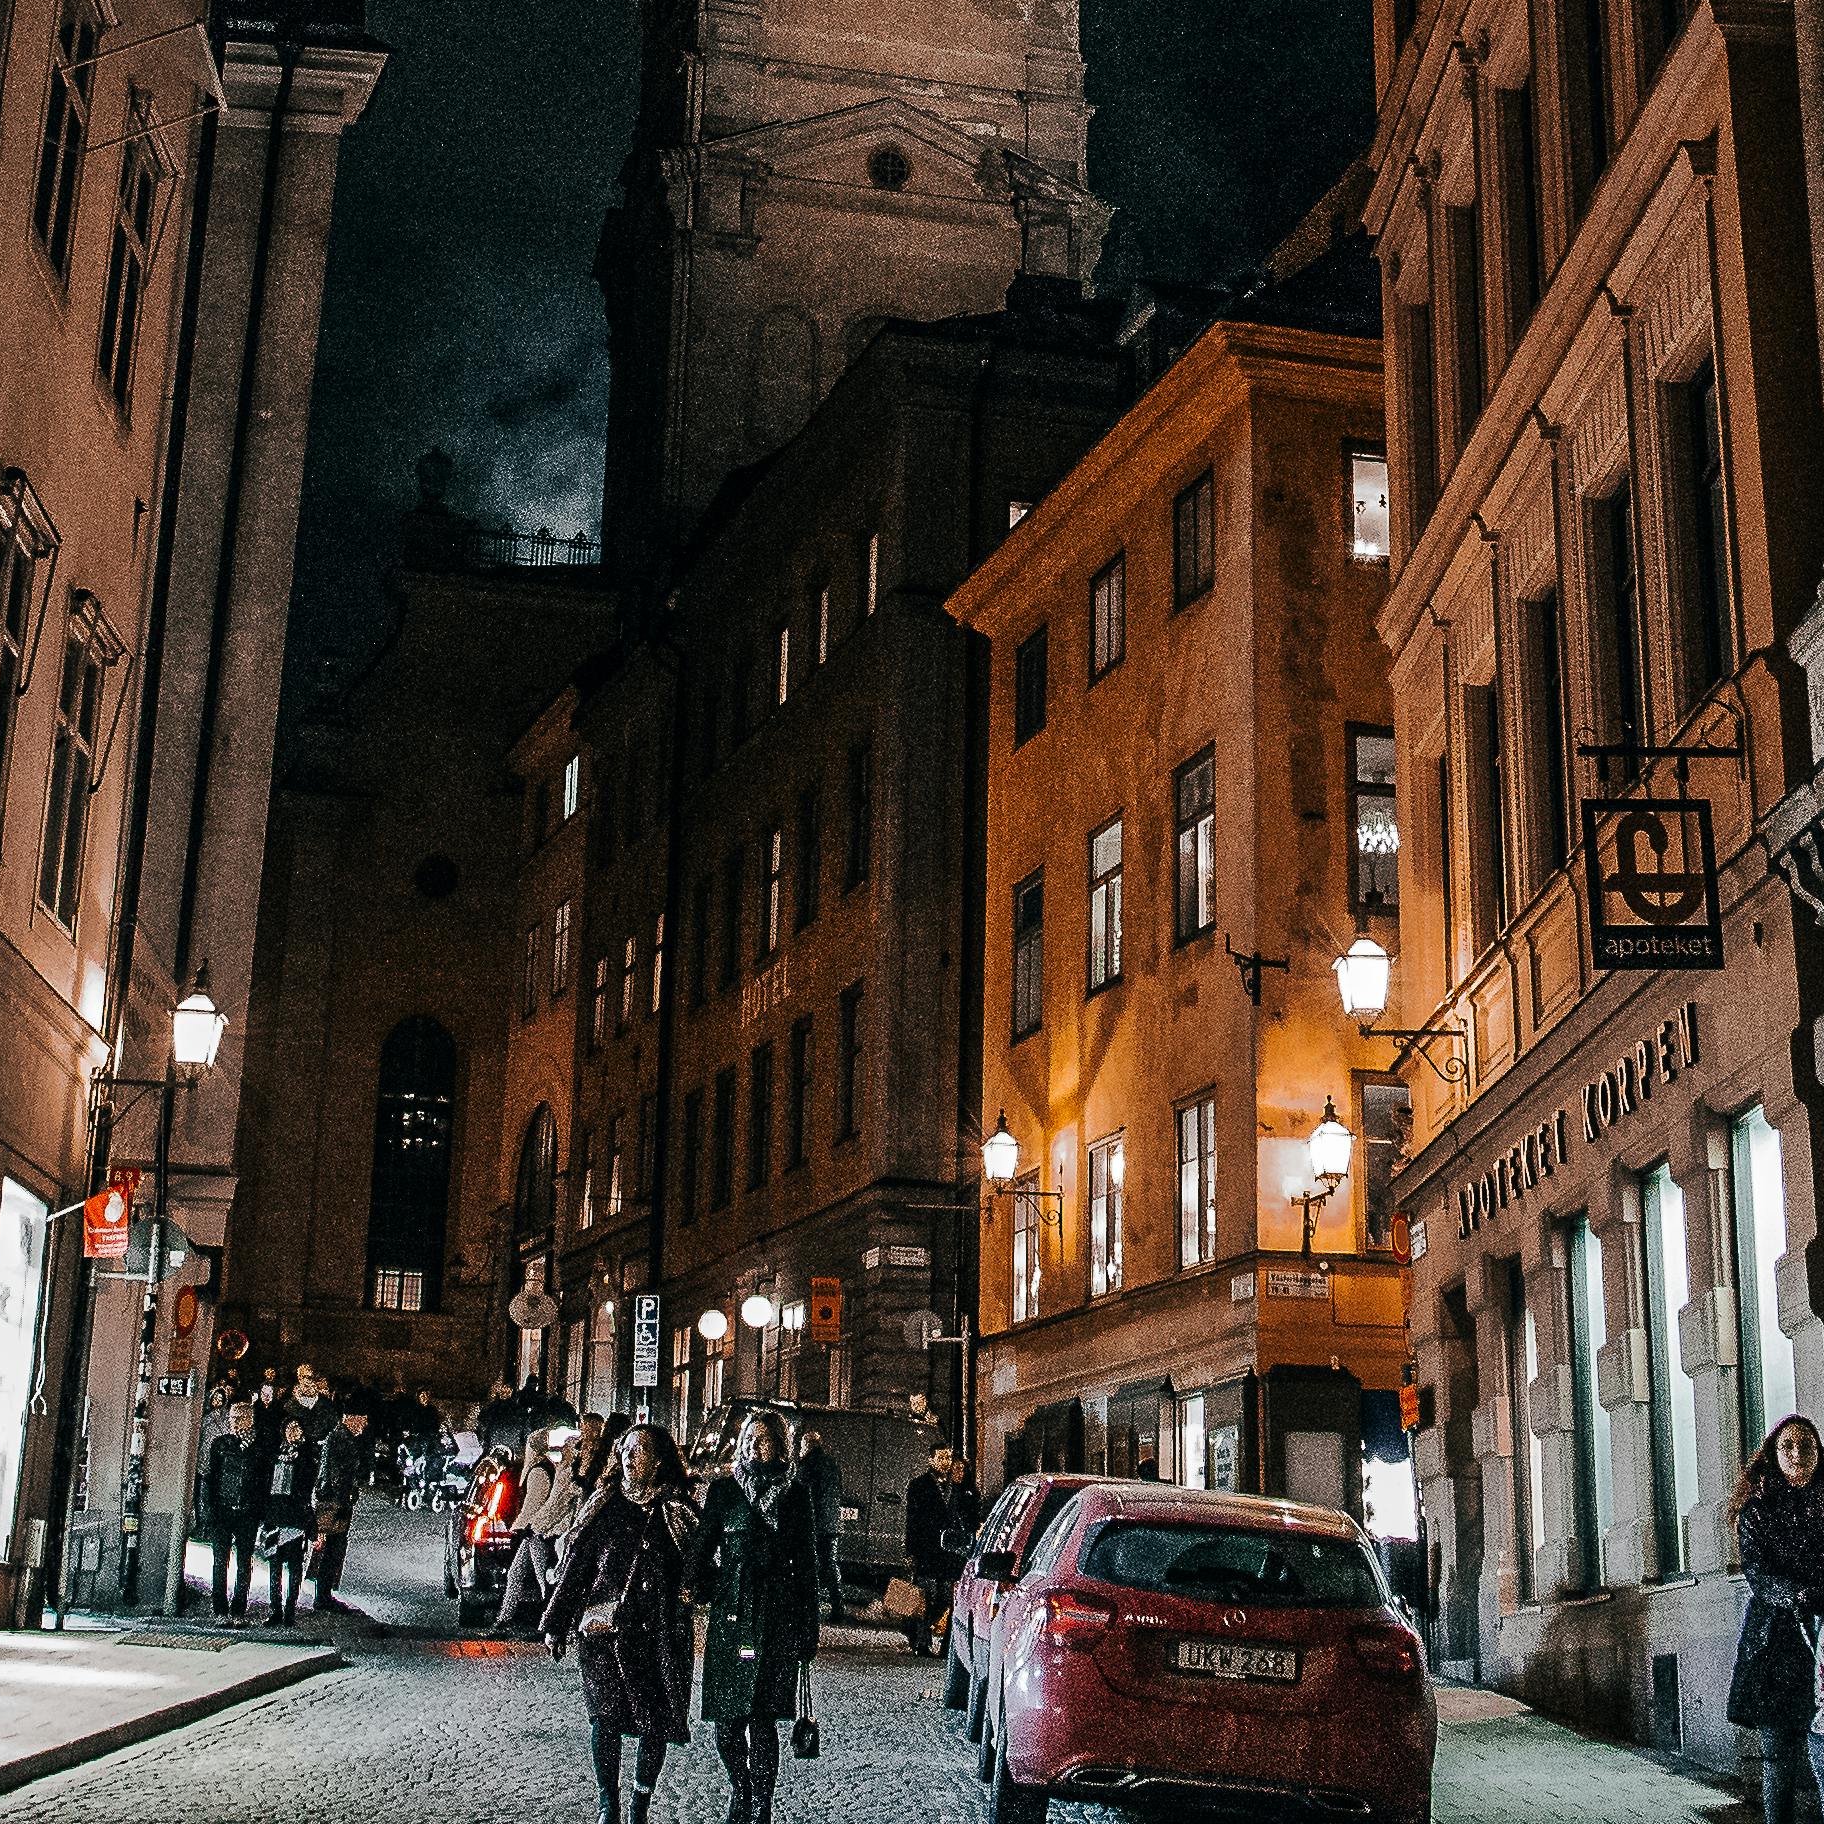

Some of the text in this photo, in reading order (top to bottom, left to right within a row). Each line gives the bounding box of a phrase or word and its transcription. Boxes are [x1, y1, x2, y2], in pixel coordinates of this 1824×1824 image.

[1604, 935, 1713, 959] apoteket
[1457, 1000, 1701, 1240] APOTEKET KORPEN
[641, 1297, 656, 1320] P
